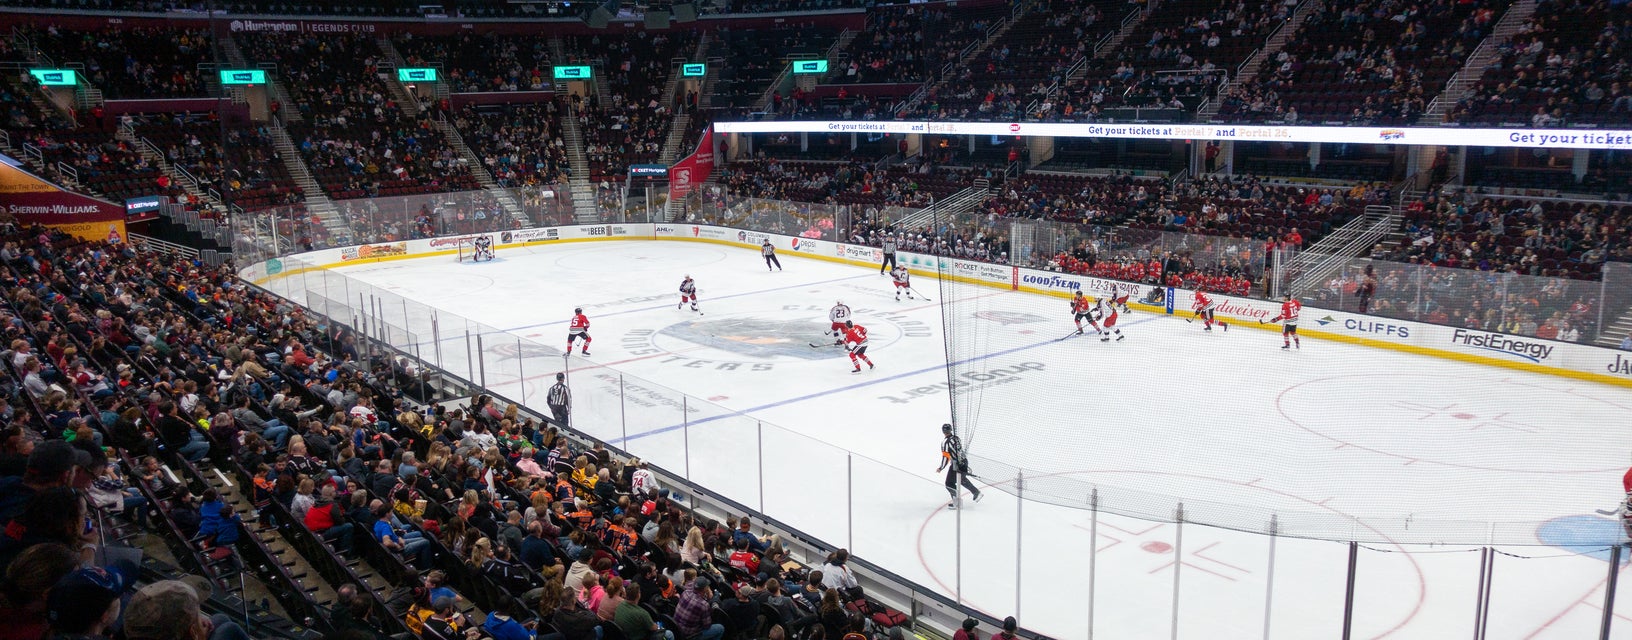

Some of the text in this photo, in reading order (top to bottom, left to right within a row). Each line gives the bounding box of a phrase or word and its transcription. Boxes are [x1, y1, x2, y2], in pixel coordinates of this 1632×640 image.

[245, 20, 297, 33] Huntington
[828, 122, 841, 130] Get
[842, 123, 857, 131] your
[1088, 126, 1103, 135] Get
[1105, 127, 1127, 136] your
[1128, 126, 1161, 136] tickets
[1162, 127, 1172, 136] at
[1174, 127, 1204, 137] Portal
[1207, 128, 1214, 137] 7
[1215, 128, 1236, 138] and
[1238, 128, 1272, 138] Portal
[1509, 132, 1535, 144] Get
[1539, 133, 1578, 146] your
[71, 224, 92, 233] GOLD
[590, 227, 606, 236] BEER
[800, 240, 816, 249] pepsi
[846, 247, 858, 257] drug
[859, 249, 871, 258] mart
[954, 262, 978, 272] ROCKET
[1023, 274, 1081, 290] GOODYEAR
[1090, 278, 1111, 291] 1-2-3
[836, 309, 845, 319] 23
[1344, 317, 1410, 338] CLIFFS
[1452, 328, 1554, 360] FirstEnergy
[619, 328, 775, 372] MONSTERS
[634, 477, 644, 488] 74
